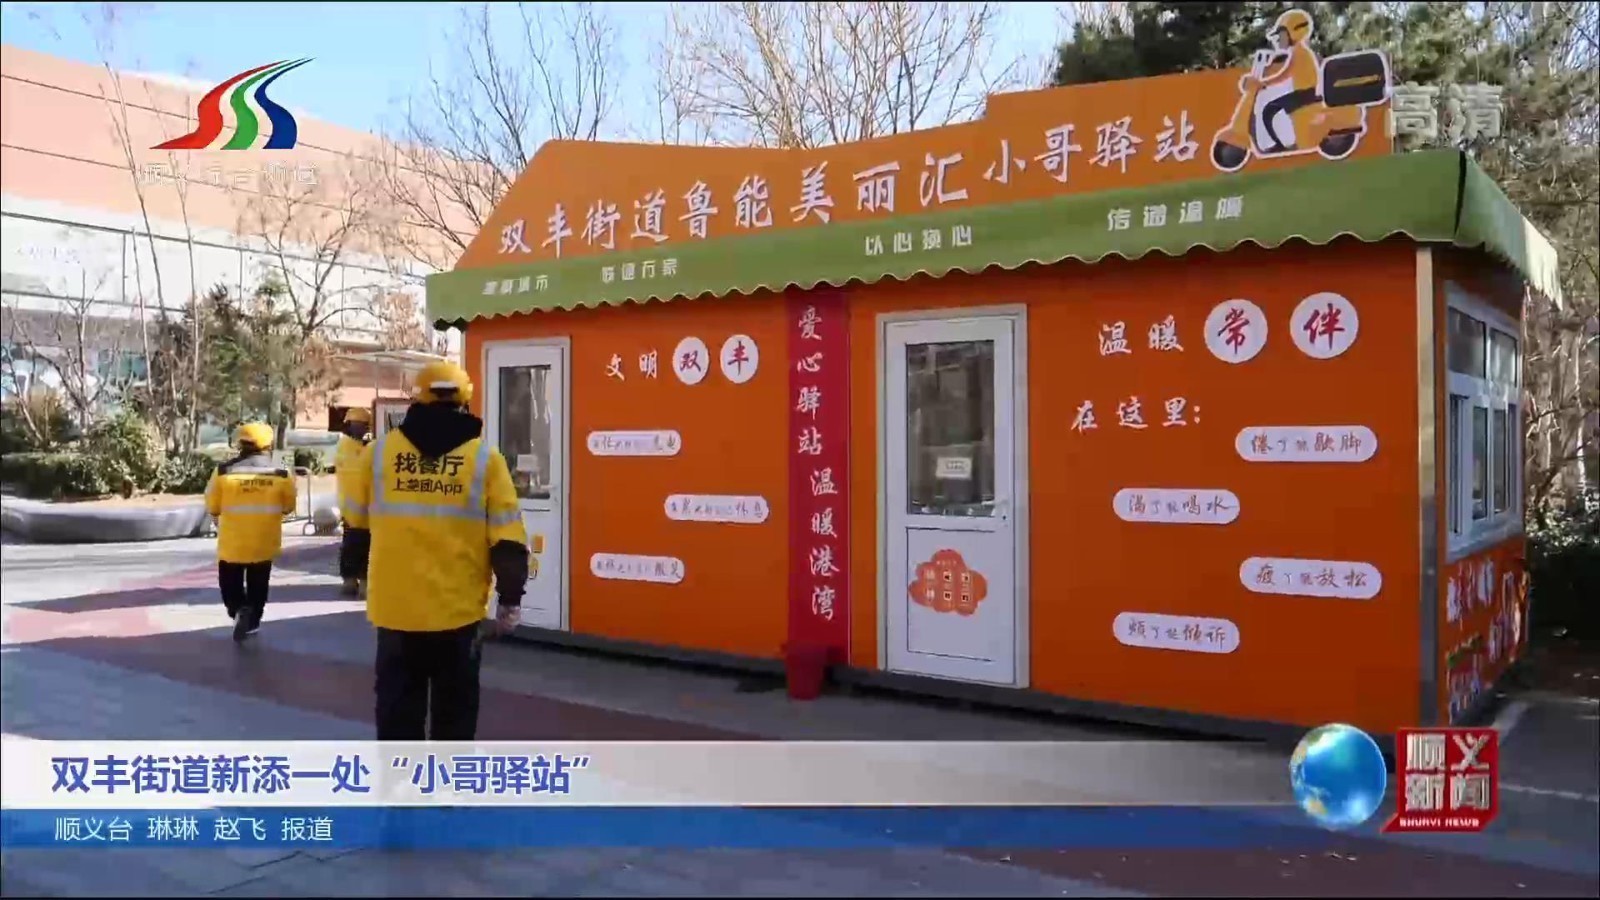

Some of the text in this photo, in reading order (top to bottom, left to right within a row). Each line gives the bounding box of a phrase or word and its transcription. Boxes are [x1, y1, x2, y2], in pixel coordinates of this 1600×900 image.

[604, 340, 750, 380] 文明双丰
[1098, 302, 1346, 357] 温暖常伴
[796, 306, 823, 456] 爱心驿站
[808, 467, 839, 622] 温暖港湾
